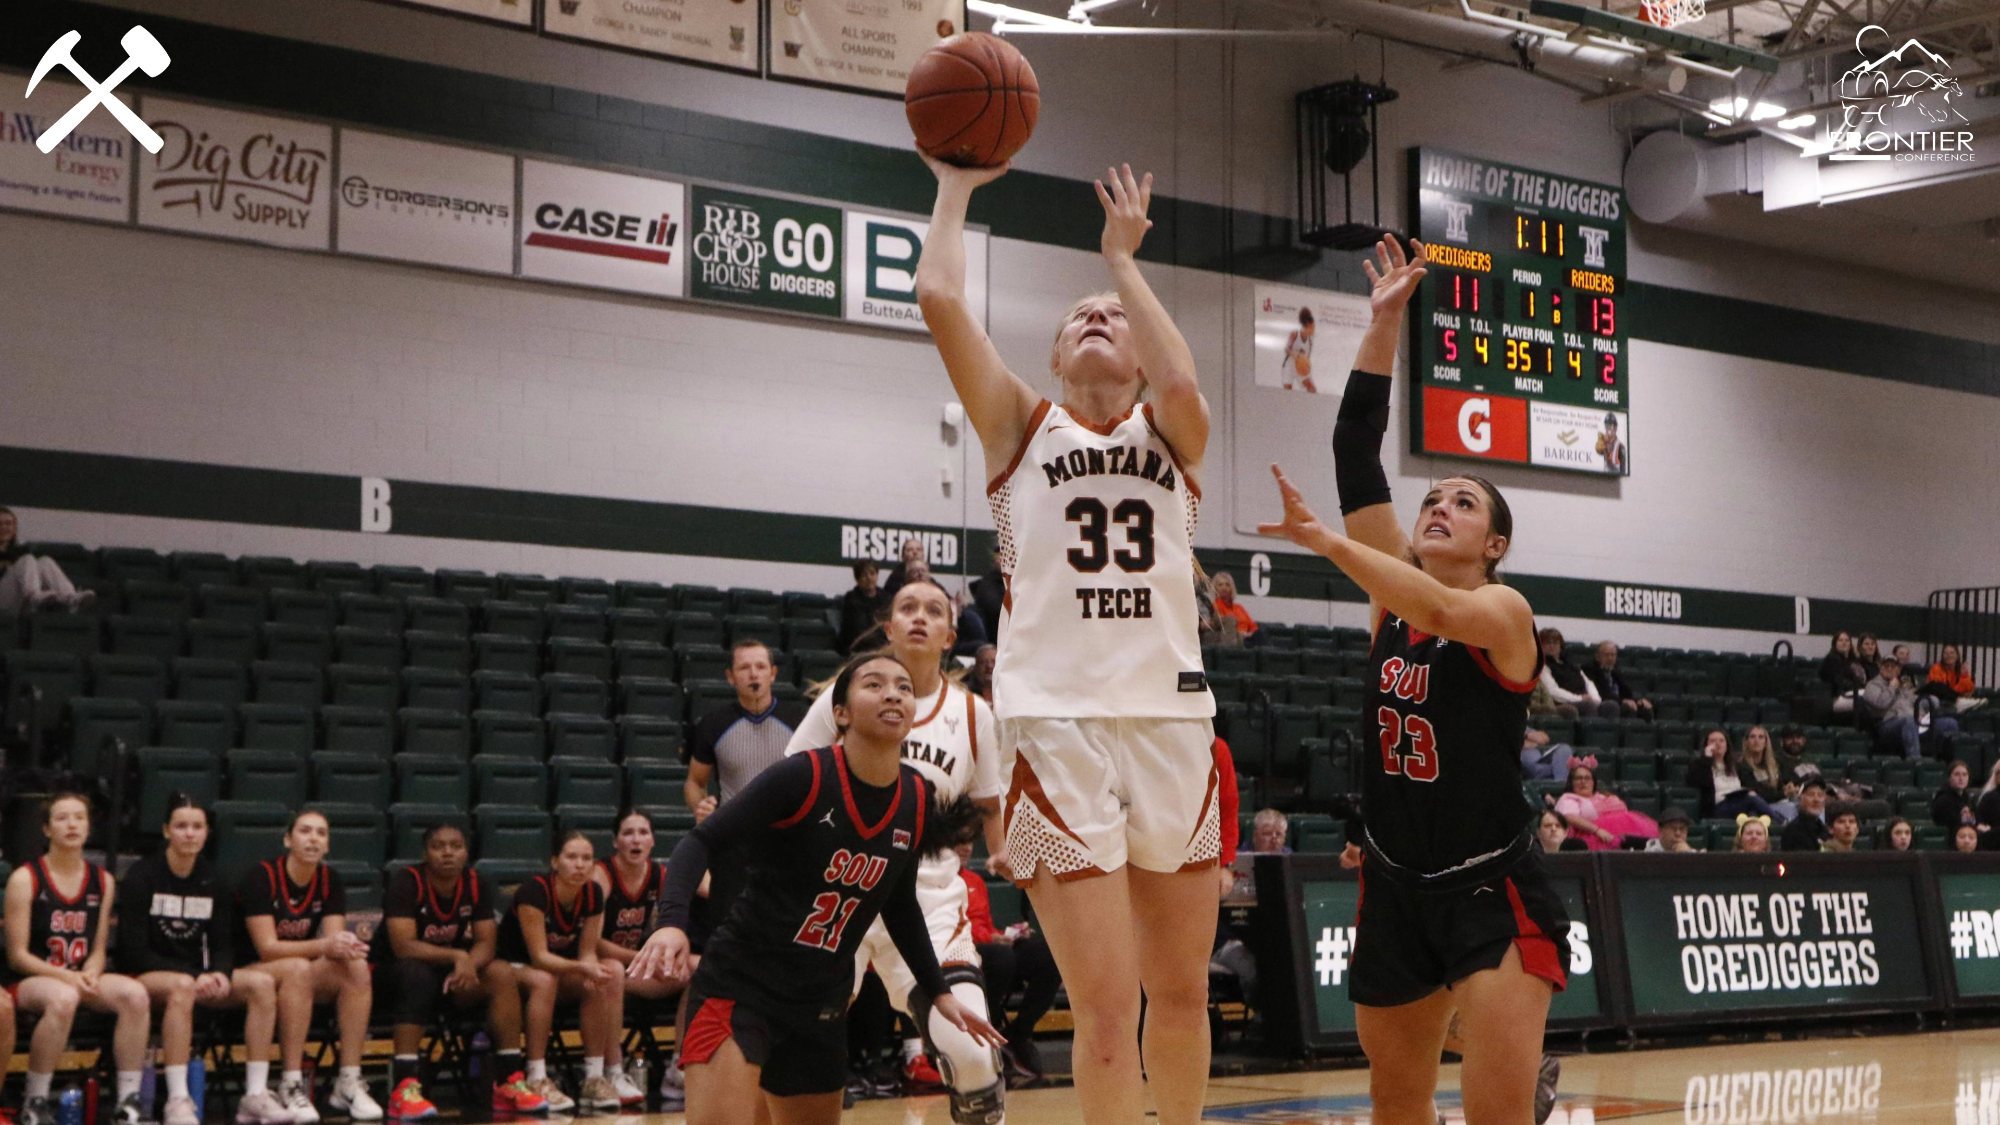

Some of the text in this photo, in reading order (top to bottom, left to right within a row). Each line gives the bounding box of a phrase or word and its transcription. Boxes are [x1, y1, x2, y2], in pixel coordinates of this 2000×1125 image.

[622, 3, 682, 21] CHAMPION
[841, 26, 897, 44] ALL SPORTS
[841, 42, 896, 60] CHAMPION
[150, 120, 327, 211] Dig City
[372, 185, 509, 218] TORGERSON'S
[1426, 156, 1620, 220] HOME OF THE DIGGERS
[232, 193, 310, 229] SUPPLY
[535, 203, 641, 241] CASE
[693, 232, 767, 268] CHOP
[773, 218, 834, 273] GO
[1425, 243, 1492, 272] OREDIGGERS
[702, 262, 761, 290] HOUSE
[770, 272, 836, 299] DIGGERS
[1513, 269, 1541, 287] PERIOD
[1571, 269, 1615, 294] RAIDERS
[1454, 275, 1478, 312] 11
[1529, 291, 1535, 317] 1
[1433, 312, 1460, 330] FOULS
[1470, 318, 1492, 334] T.O.L.
[1553, 309, 1561, 325] B
[1592, 298, 1615, 336] 13
[1443, 329, 1457, 362] 5
[1475, 336, 1488, 364] 4
[1502, 323, 1555, 345] PLAYER FOUL
[1563, 332, 1585, 349] T.O.L.
[1593, 337, 1618, 354] FOULS
[1506, 339, 1552, 373] 35 1
[1568, 350, 1581, 377] 4
[1603, 354, 1615, 384] 2
[1433, 365, 1461, 382] SCORE
[1515, 376, 1543, 393] MATCH
[1594, 388, 1619, 404] SCORE
[1458, 398, 1491, 453] G
[1042, 446, 1176, 492] MONTANA
[1544, 446, 1592, 463] BARRICK
[361, 477, 392, 533] B
[1065, 497, 1155, 573] 33
[1251, 553, 1271, 597] C
[1076, 588, 1152, 619] TECH
[1605, 586, 1682, 619] RESERVED
[1795, 596, 1810, 634] D
[900, 740, 956, 776] NTANA
[1378, 706, 1439, 782] 23
[824, 848, 888, 891] SOU
[50, 909, 87, 933] SOU
[793, 892, 861, 953] 21
[1673, 892, 1873, 940] HOME OF THE
[1681, 939, 1880, 994] OREDIGGERS
